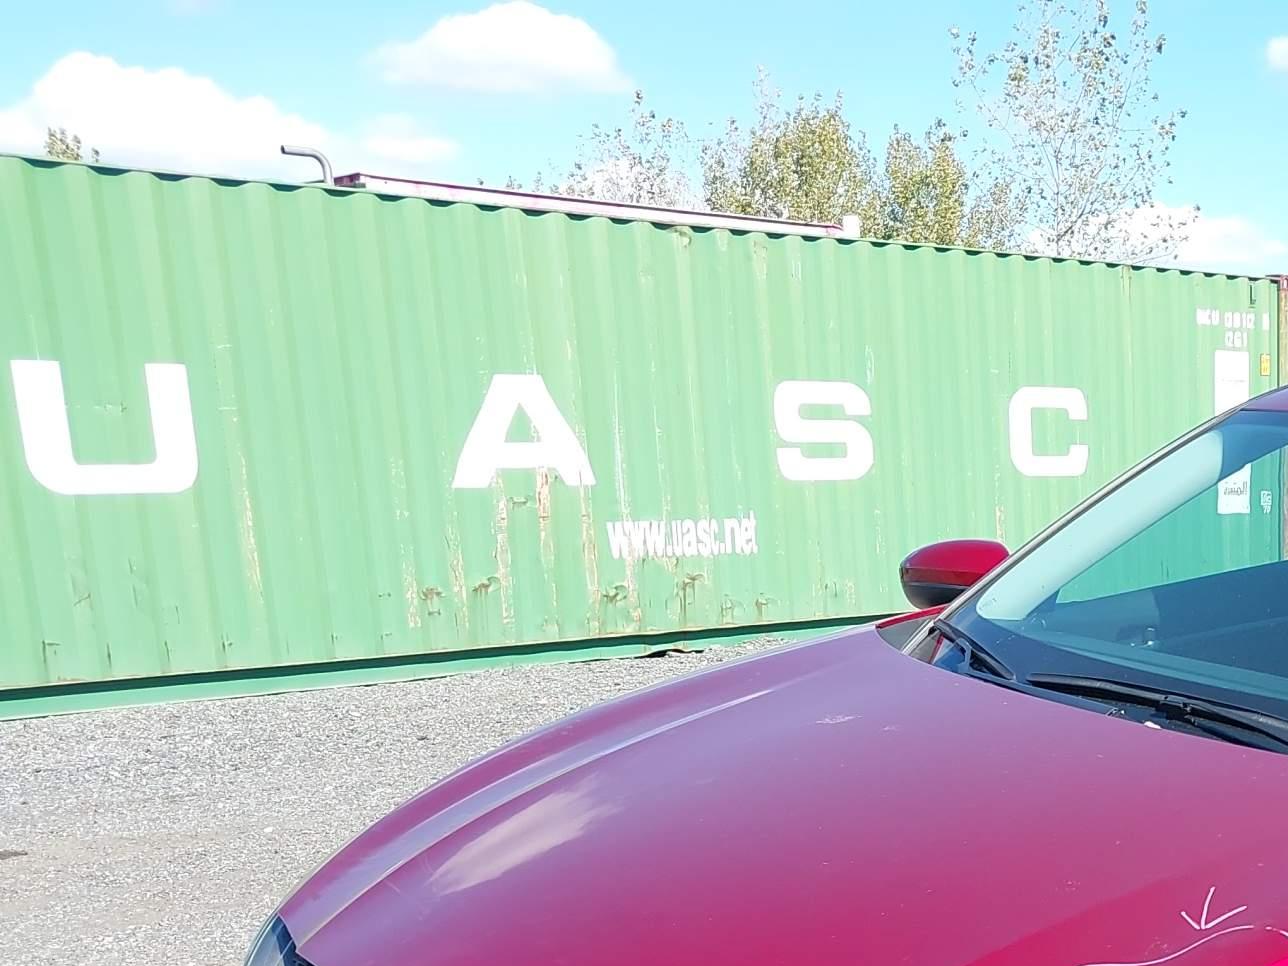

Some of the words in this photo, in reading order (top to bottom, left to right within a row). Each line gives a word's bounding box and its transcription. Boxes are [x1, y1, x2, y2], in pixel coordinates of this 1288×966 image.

[11, 360, 198, 495] U
[452, 373, 596, 489] A
[773, 380, 873, 481] S
[1008, 386, 1089, 478] C
[606, 511, 758, 559] www.uasc.net
